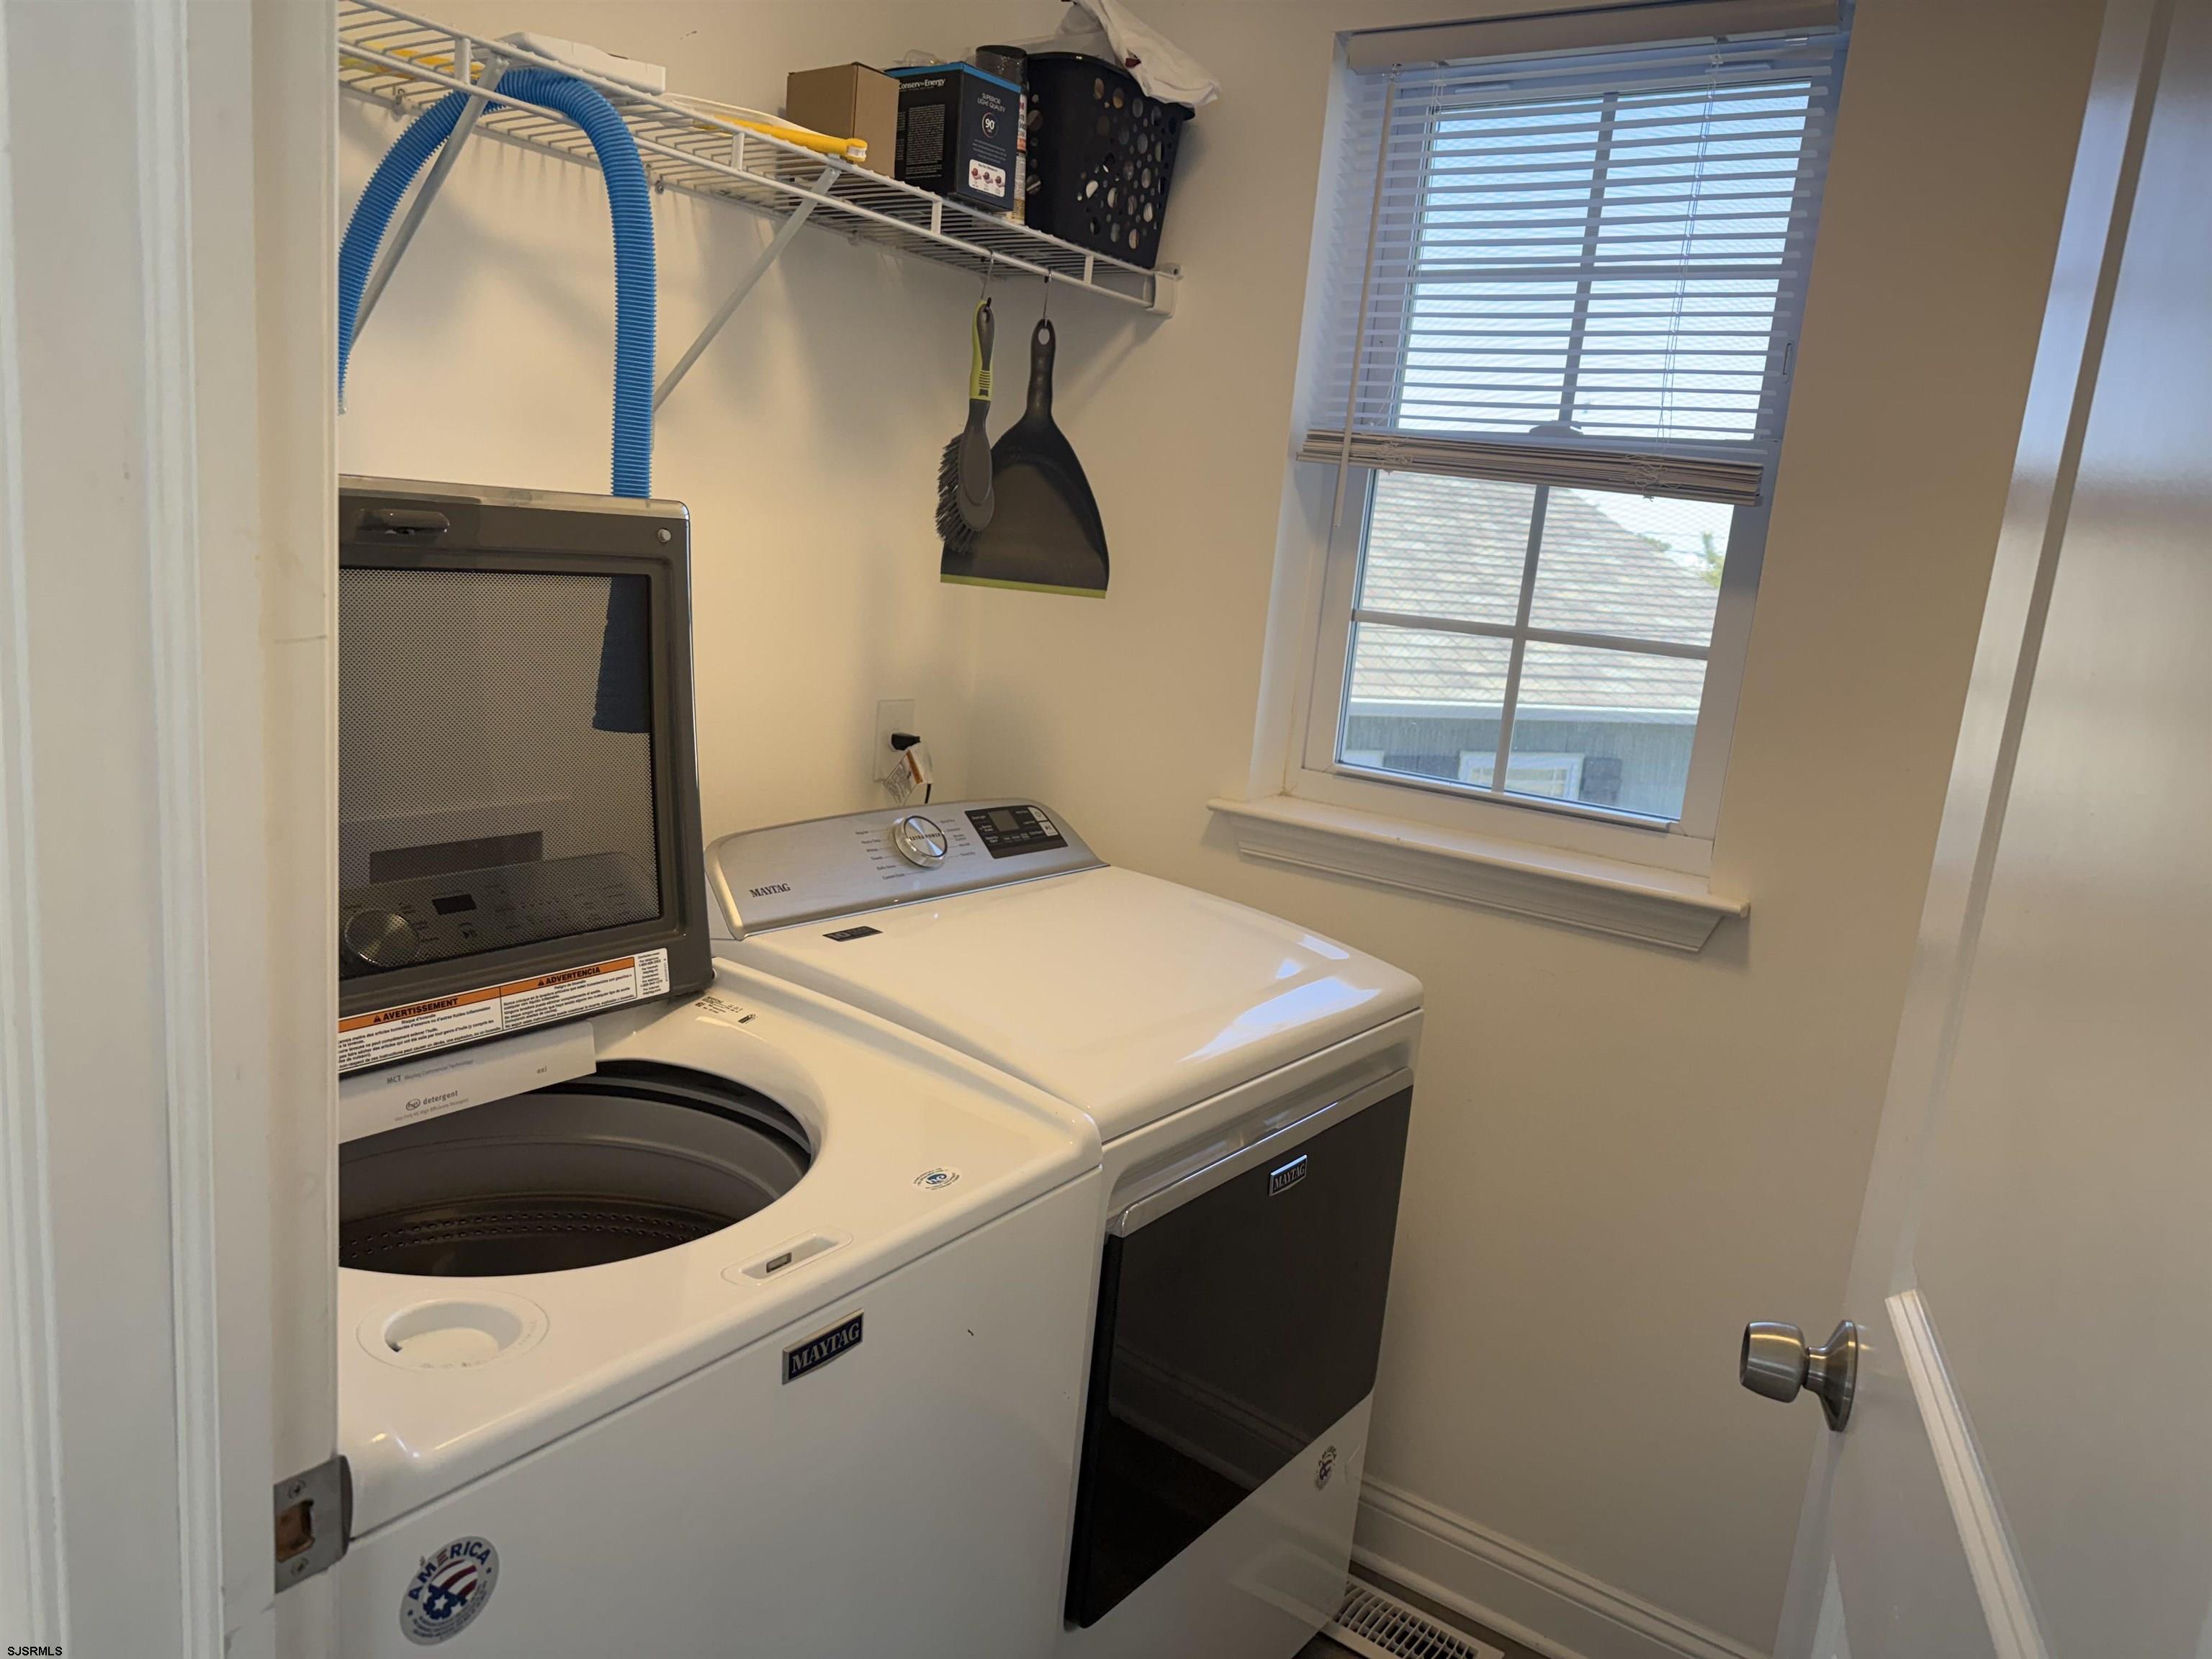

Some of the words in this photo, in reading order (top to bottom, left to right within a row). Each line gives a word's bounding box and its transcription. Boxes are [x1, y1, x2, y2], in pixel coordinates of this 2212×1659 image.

[982, 93, 1001, 104] SUPERIOR
[749, 883, 791, 897] MAYTAG
[546, 967, 601, 984] ADVERTENCIA
[383, 998, 458, 1021] AVERTISSEMENT
[536, 1066, 547, 1074] oxi
[387, 1075, 401, 1084] MCT
[423, 1090, 458, 1105] detergent
[1274, 1163, 1305, 1190] MAYTAG
[791, 1323, 860, 1373] MAYTAG
[408, 1541, 490, 1600] AMERICA
